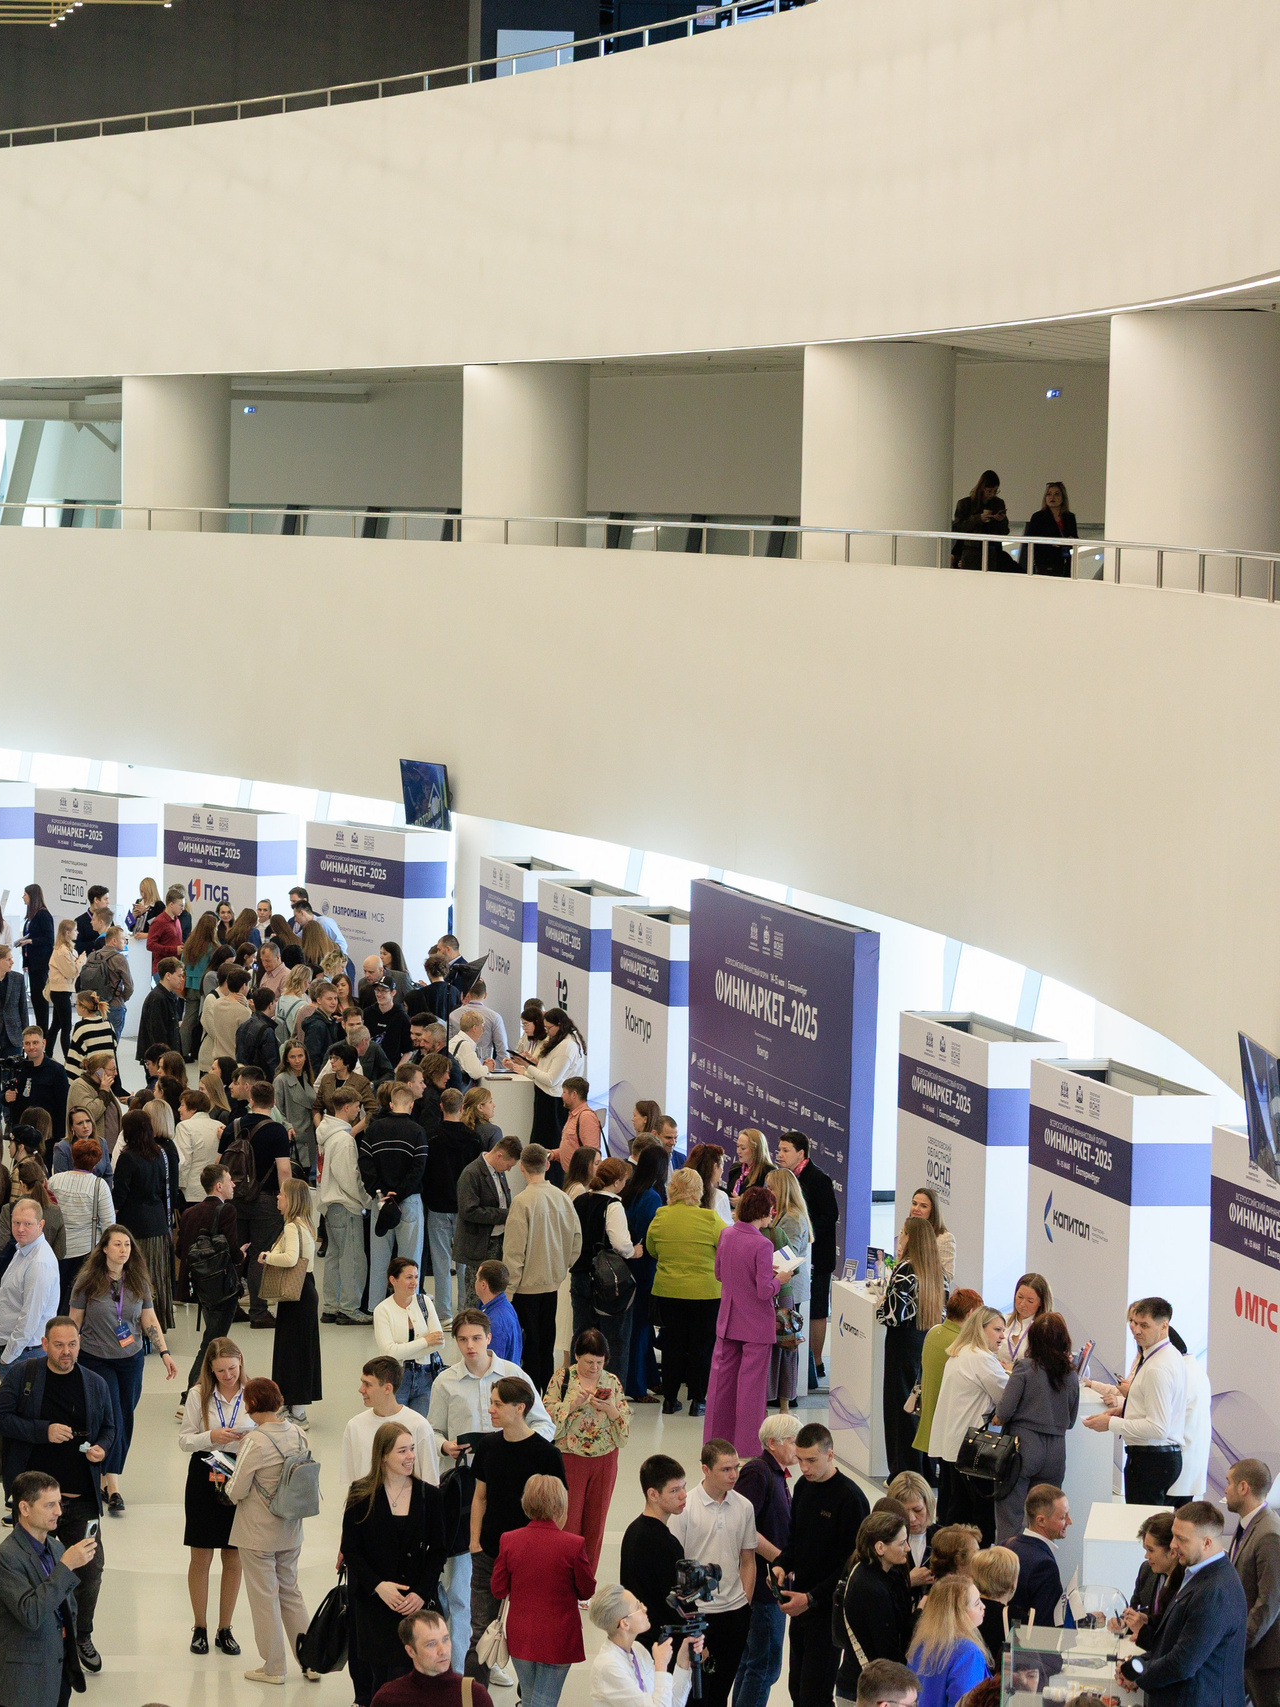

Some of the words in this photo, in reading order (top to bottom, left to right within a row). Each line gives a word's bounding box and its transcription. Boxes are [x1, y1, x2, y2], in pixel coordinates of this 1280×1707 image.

[64, 883, 84, 897] ВДЕЛО
[204, 884, 229, 901] ПСБ
[332, 905, 367, 919] ГАЗПРОМБАНК
[372, 913, 384, 922] МСБ
[625, 1006, 652, 1044] Контур
[927, 1159, 950, 1189] ФОНД
[1245, 1291, 1278, 1333] МТС
